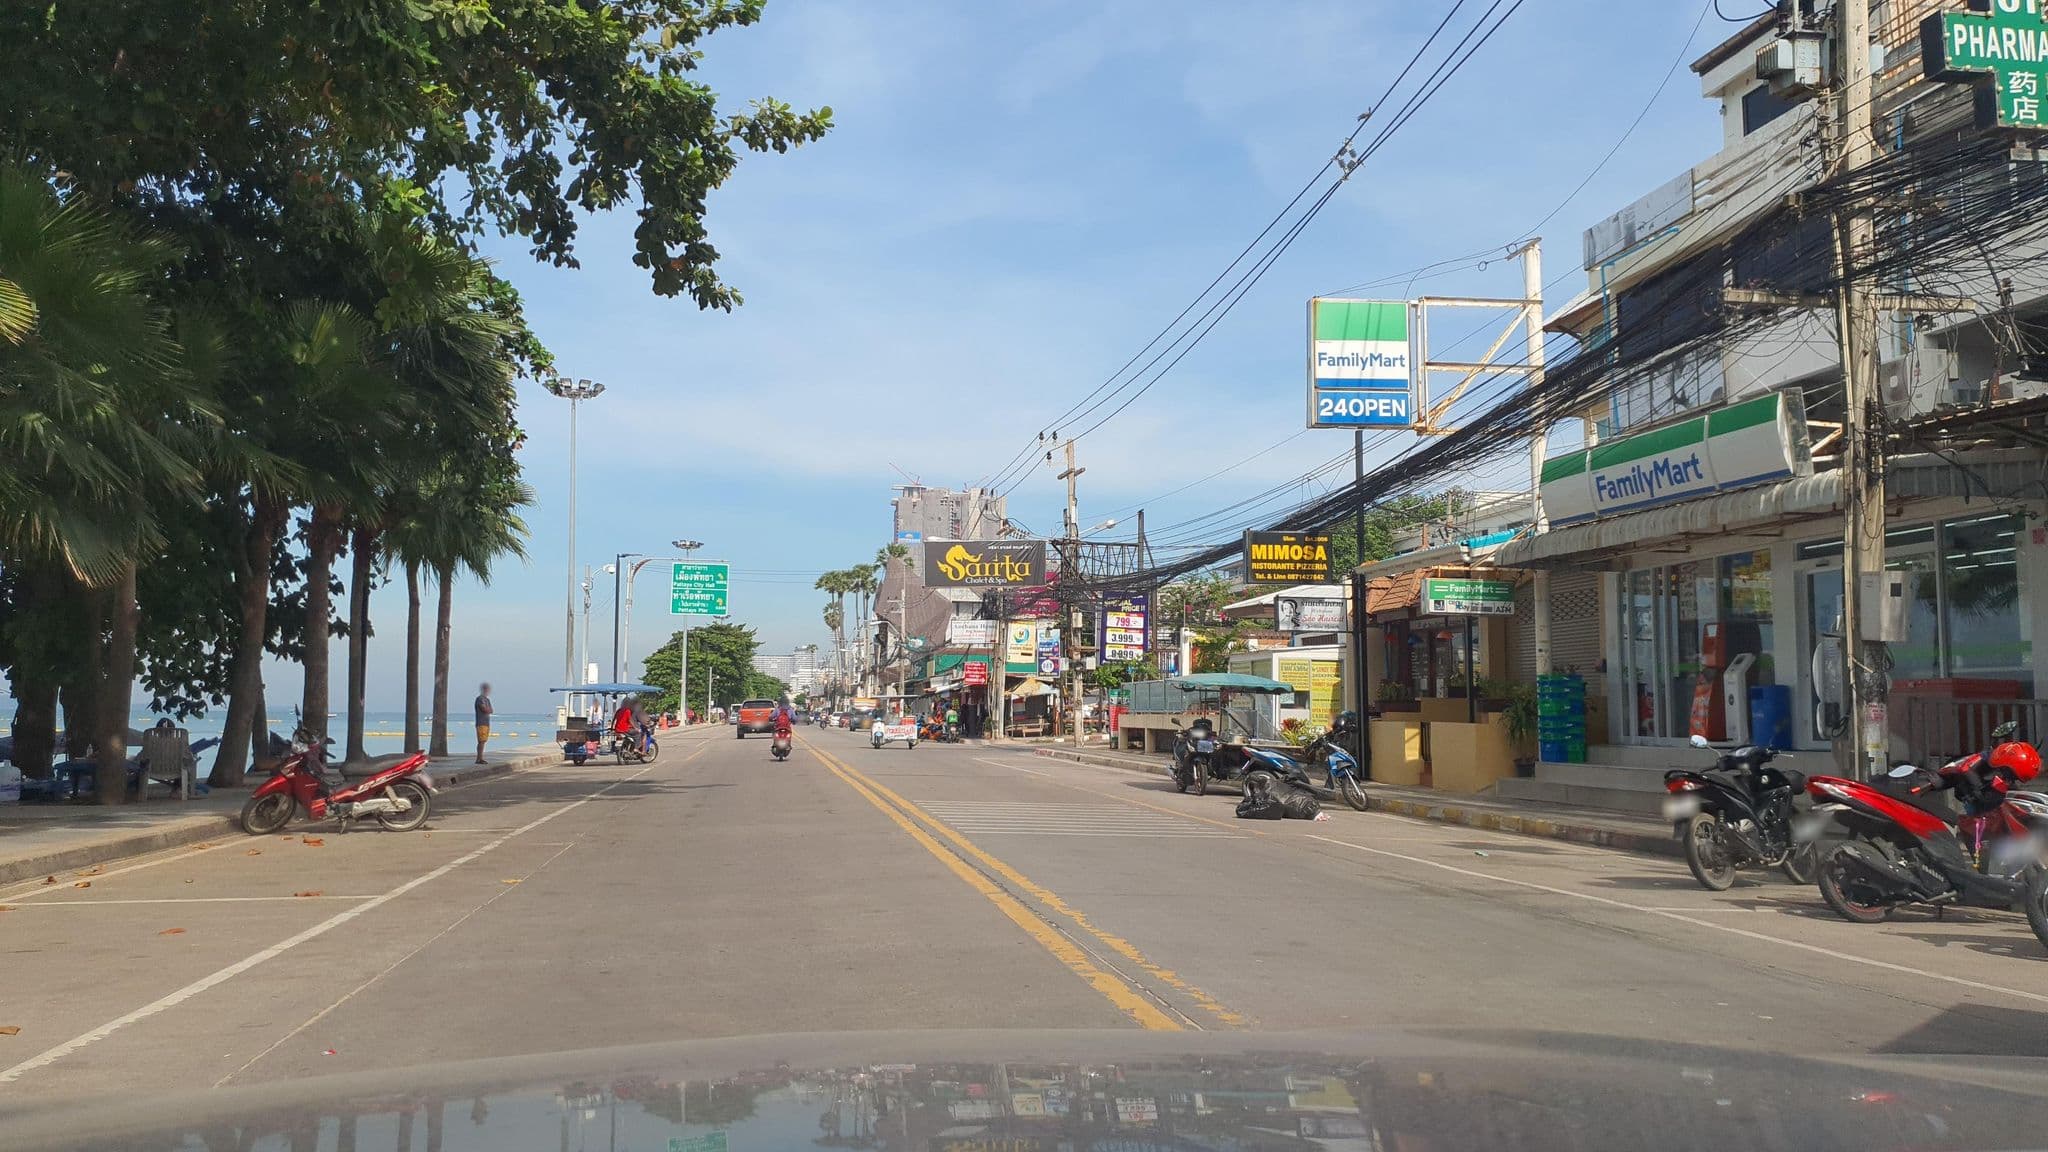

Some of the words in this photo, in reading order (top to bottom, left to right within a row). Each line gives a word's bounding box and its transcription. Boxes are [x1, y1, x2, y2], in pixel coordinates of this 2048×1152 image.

[2007, 71, 2039, 121] 药店
[1317, 352, 1406, 371] FamilyMart
[1596, 452, 1704, 502] FamilyMart
[1251, 544, 1327, 560] MIMOSA
[1251, 562, 1295, 570] RISTORANTE
[1296, 563, 1328, 571] PIZZERIA
[995, 577, 1007, 585] Spa
[1449, 583, 1494, 594] FamilyMart
